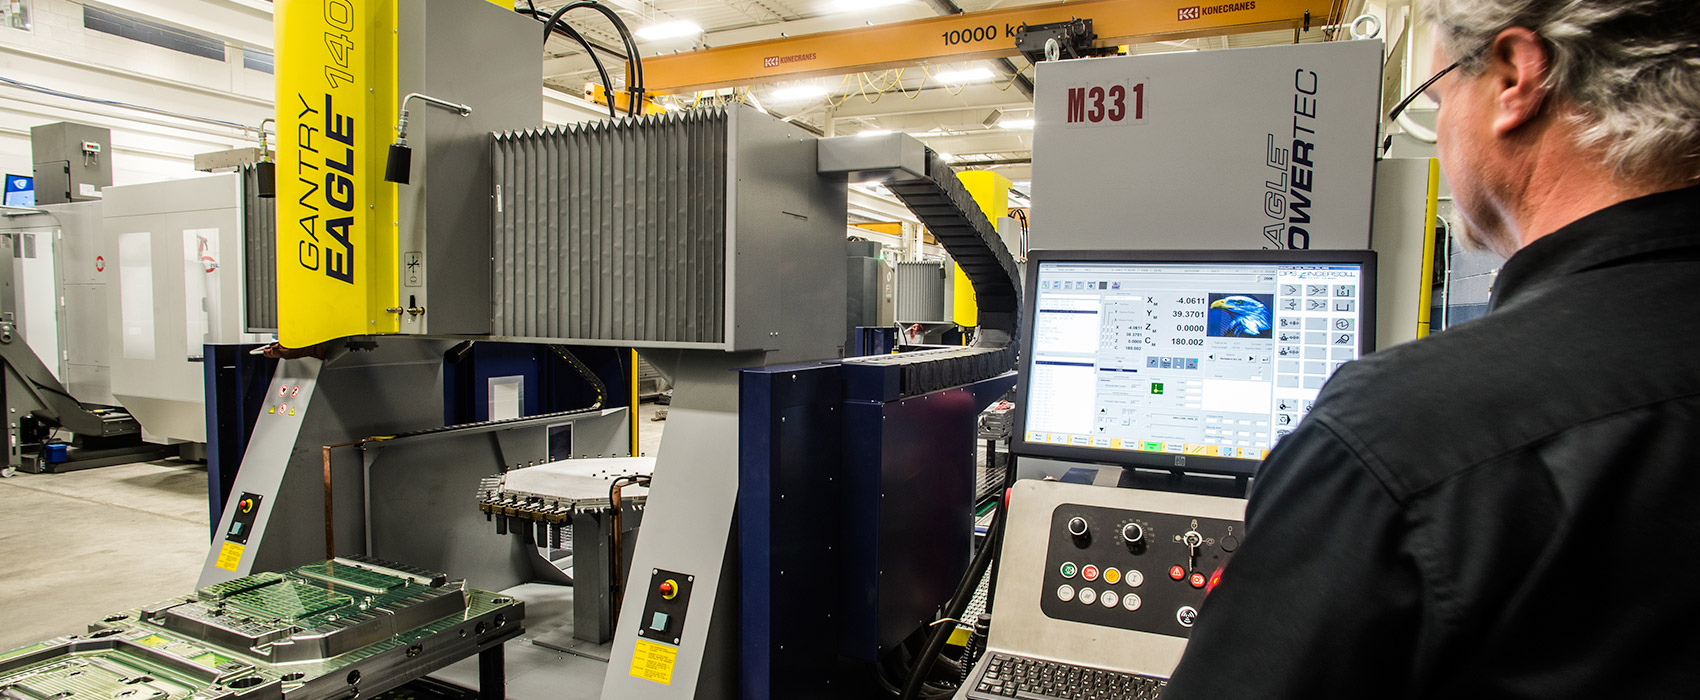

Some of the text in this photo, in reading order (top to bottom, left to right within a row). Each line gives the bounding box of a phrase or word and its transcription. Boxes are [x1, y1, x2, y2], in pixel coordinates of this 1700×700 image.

[1202, 1, 1256, 15] KONECRANES
[942, 25, 997, 46] 10000
[780, 53, 817, 64] KONECRANES
[1067, 83, 1144, 123] M331
[298, 92, 319, 272] GANTRY
[325, 93, 354, 284] EAGLE
[1262, 133, 1289, 250] AGLE
[1176, 297, 1205, 305] -4.0611
[1172, 310, 1205, 318] 39.3701
[1176, 324, 1204, 332] 0.0000
[1171, 338, 1204, 346] 180.002
